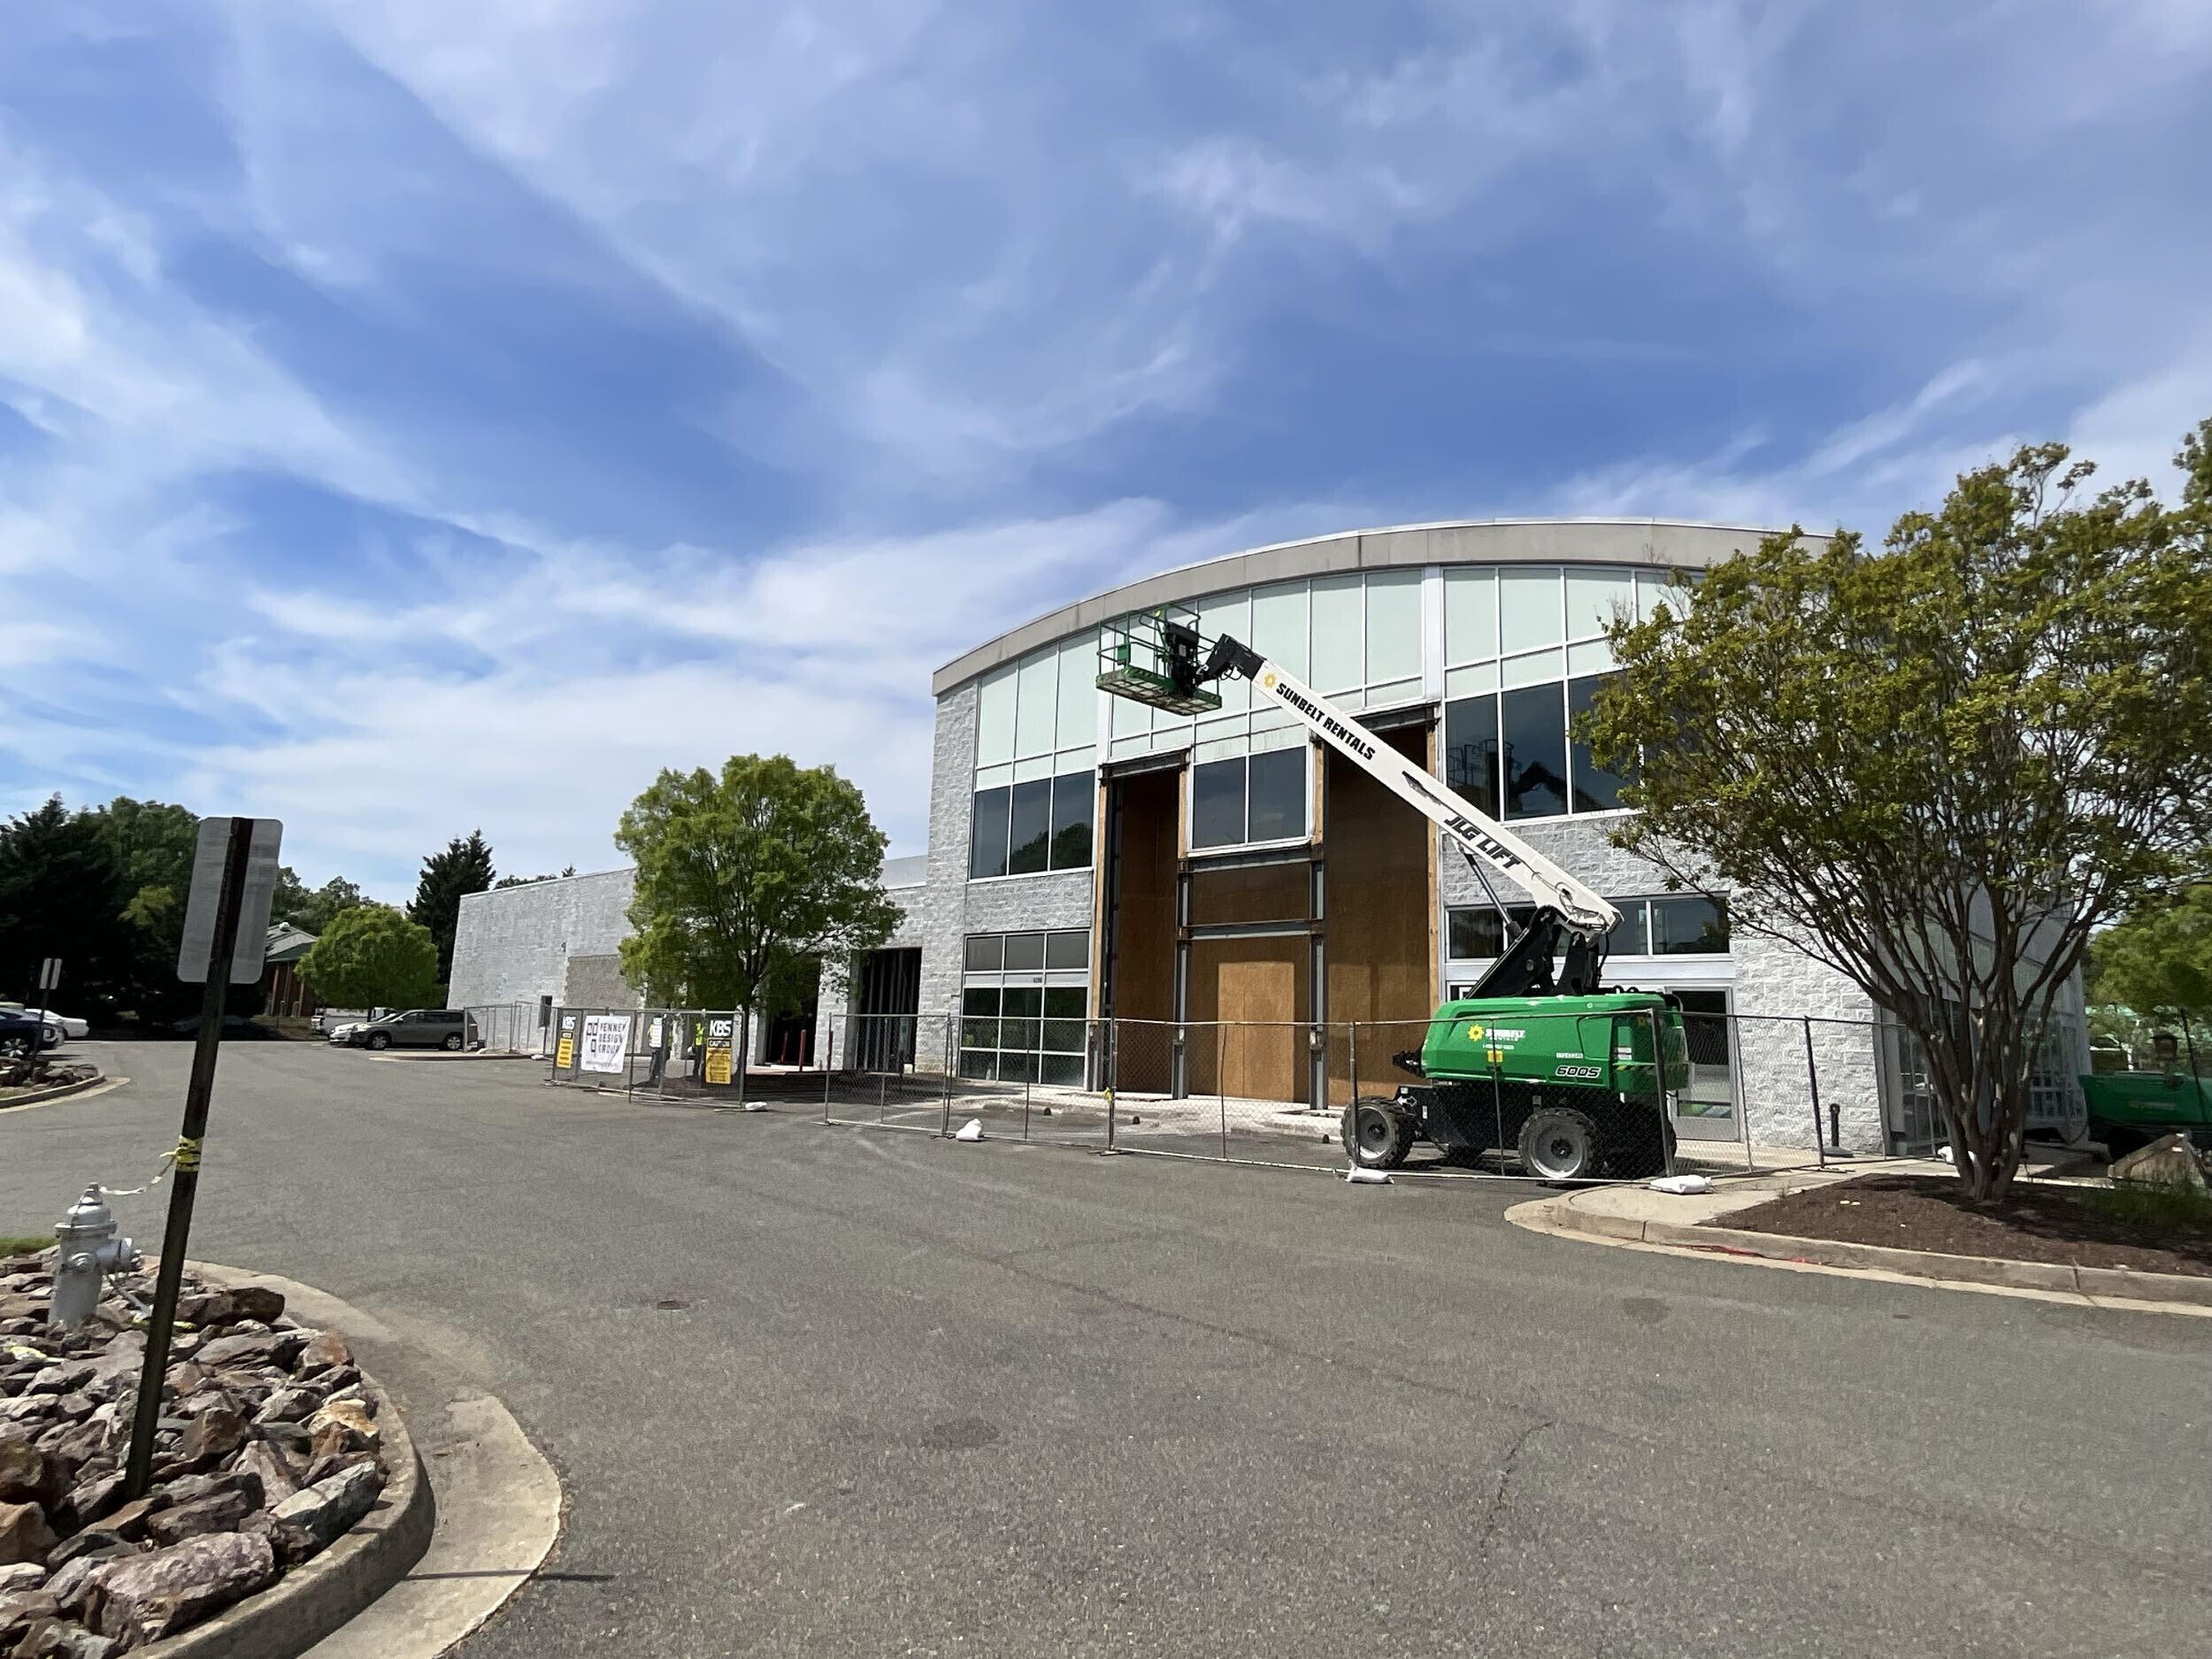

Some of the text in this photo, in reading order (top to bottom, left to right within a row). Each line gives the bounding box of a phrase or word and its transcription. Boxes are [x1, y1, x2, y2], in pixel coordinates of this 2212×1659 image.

[1276, 682, 1376, 761] SUNBELT RENTALS
[1443, 815, 1521, 869] JLG LIFT
[710, 1019, 732, 1036] KBS
[598, 1033, 623, 1044] DESIGN
[1555, 1064, 1601, 1079] 600S
